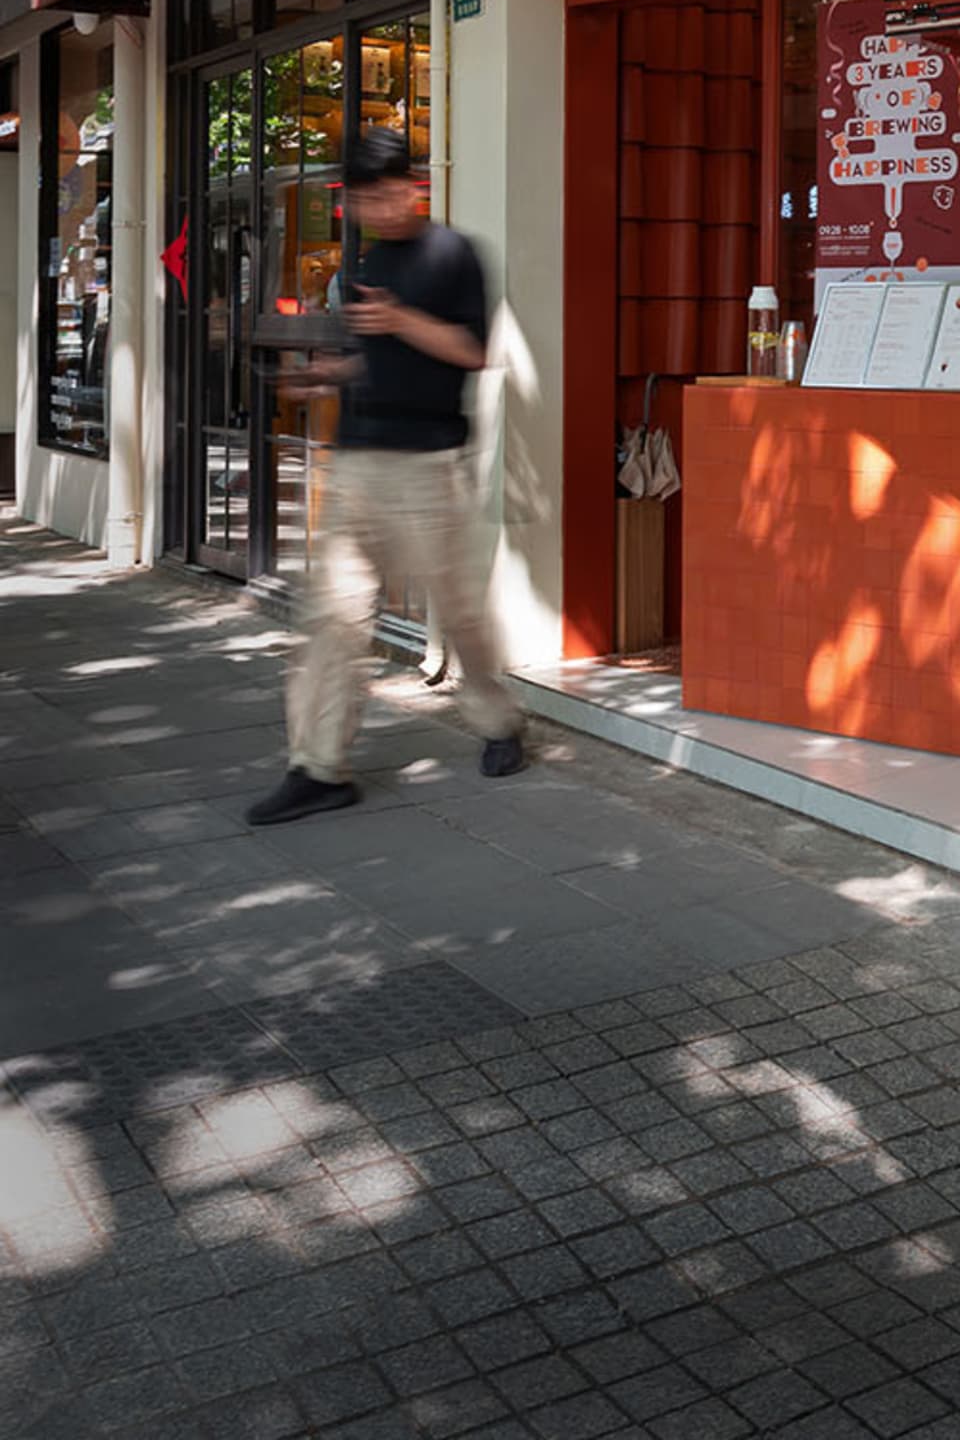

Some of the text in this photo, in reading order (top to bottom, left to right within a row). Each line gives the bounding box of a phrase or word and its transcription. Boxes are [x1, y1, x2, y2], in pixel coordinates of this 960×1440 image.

[854, 58, 938, 82] 3 YEARS
[886, 88, 916, 108] OF
[848, 115, 942, 137] BREWING
[834, 156, 952, 178] HAPPINESS
